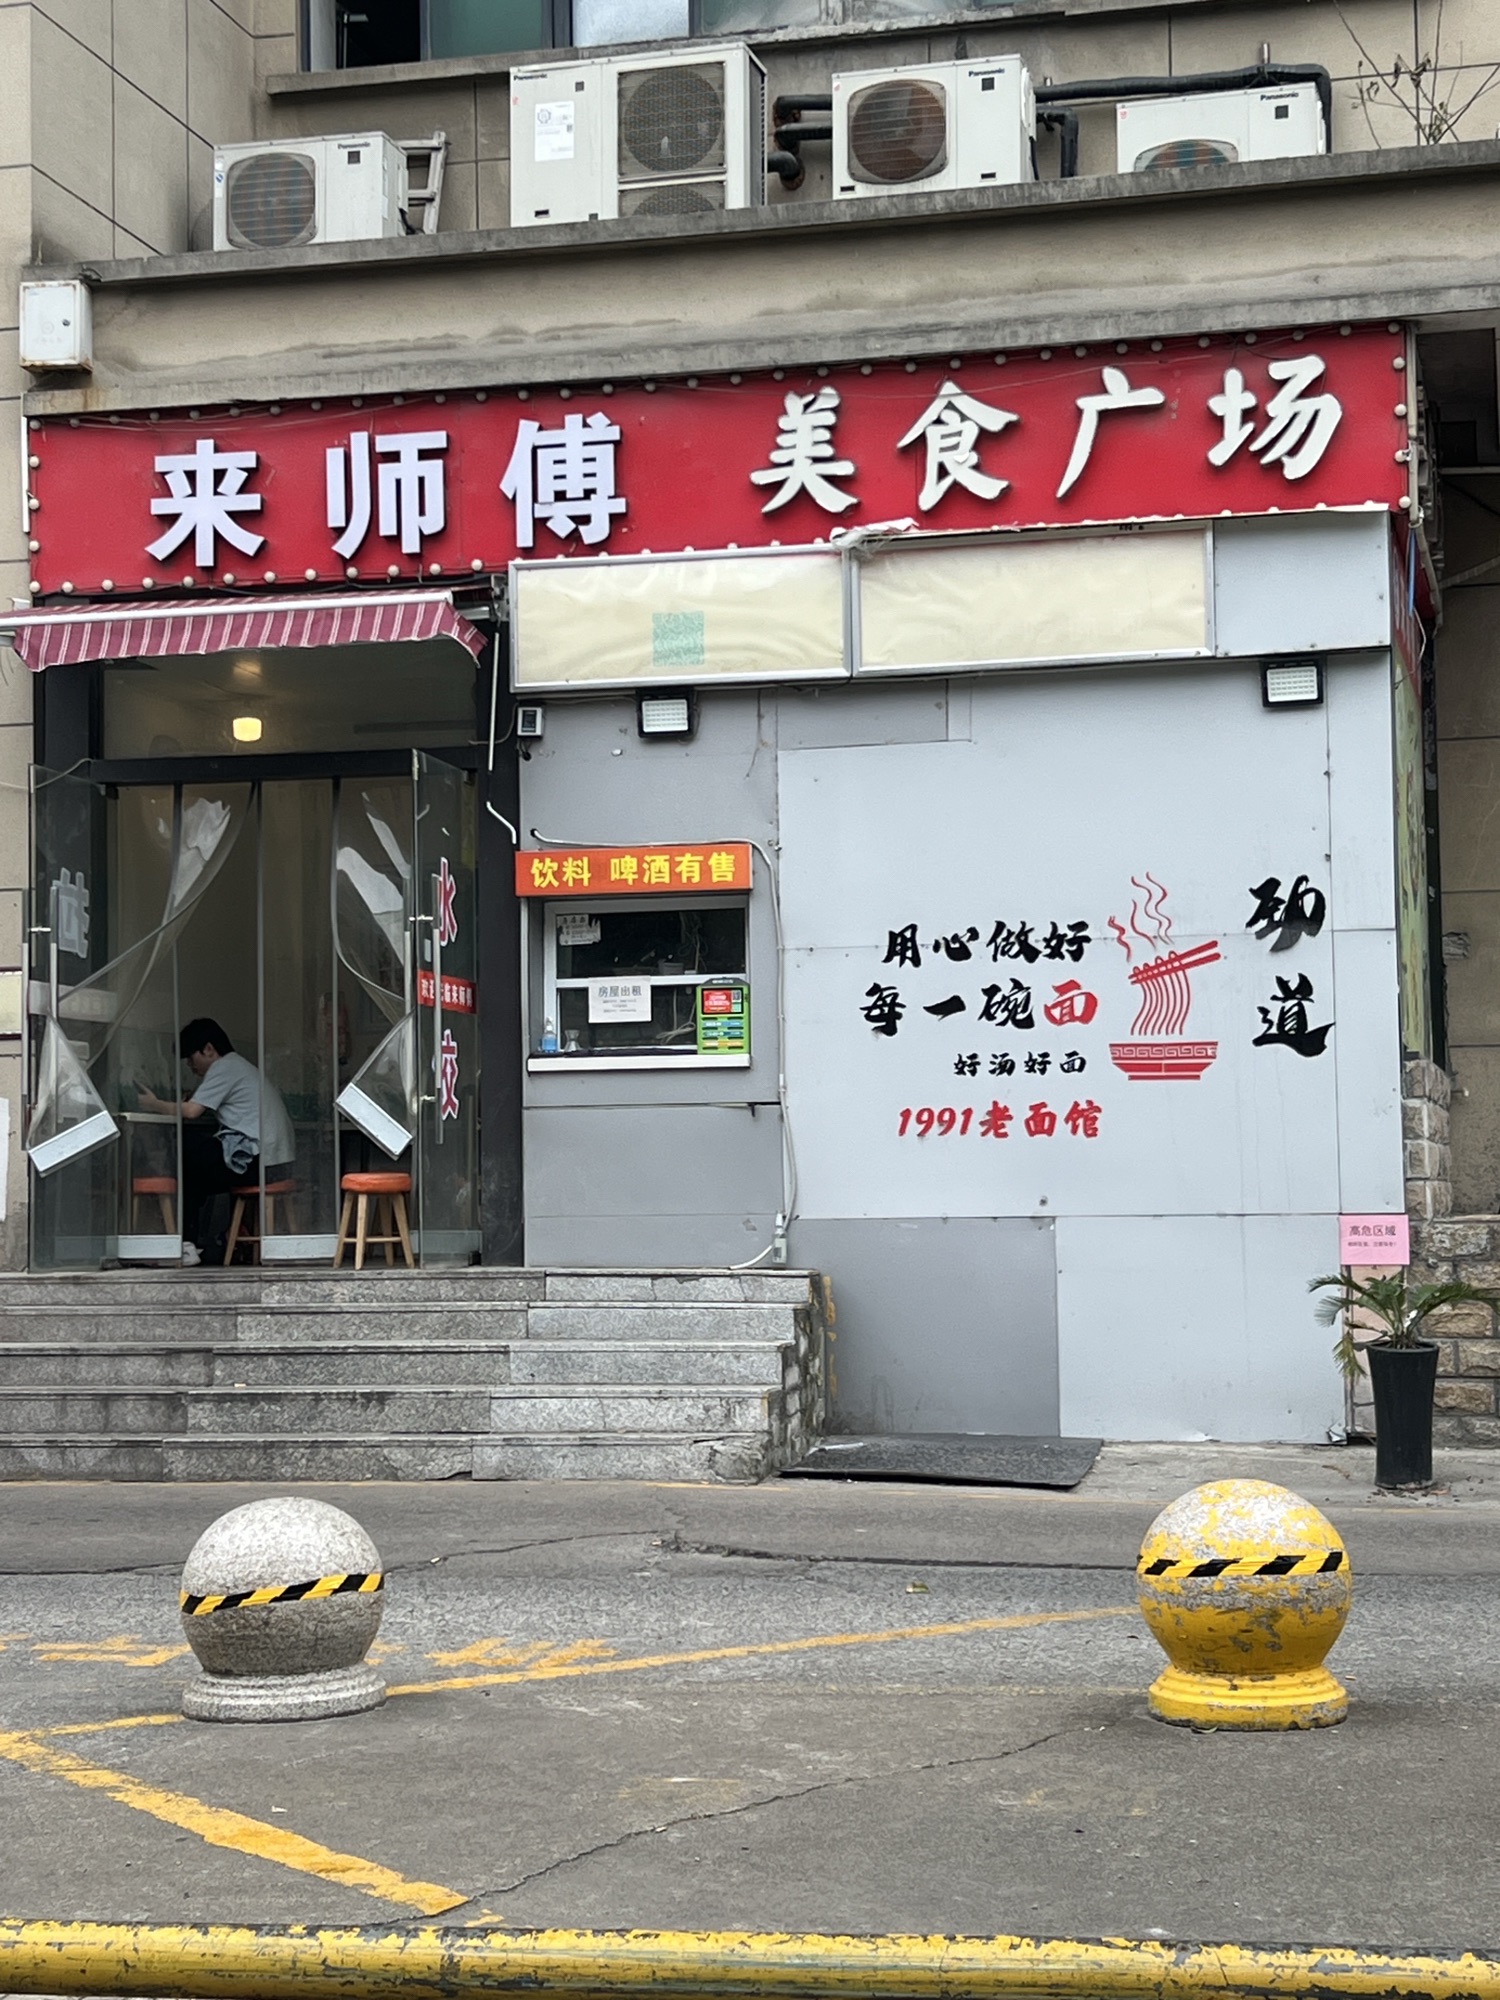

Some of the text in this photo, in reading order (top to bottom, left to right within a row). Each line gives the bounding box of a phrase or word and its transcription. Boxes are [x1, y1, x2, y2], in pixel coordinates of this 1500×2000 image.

[145, 354, 1343, 568] 来师傅 美食广场
[530, 851, 736, 888] 饮料 啤酒有售
[882, 920, 1093, 969] 用心做好
[1245, 874, 1336, 1058] 劲道
[598, 985, 642, 998] 房屋出租
[859, 978, 1099, 1037] 每一碗面
[953, 1050, 1087, 1077] 好汤好面
[898, 1099, 1103, 1139] 1991老面馆
[1349, 1224, 1396, 1237] 高危区域
